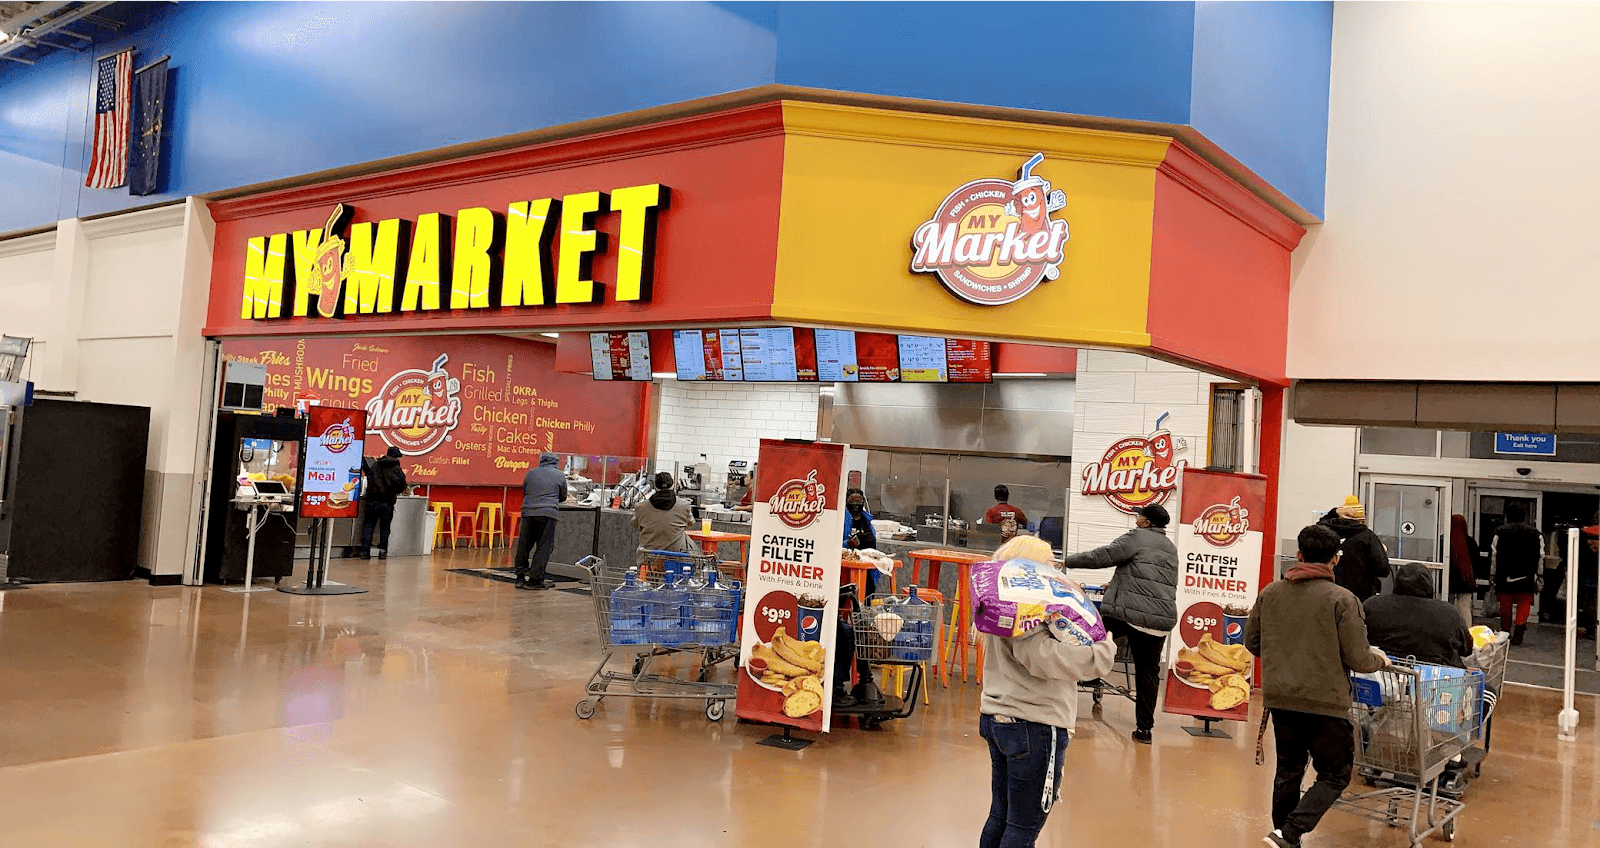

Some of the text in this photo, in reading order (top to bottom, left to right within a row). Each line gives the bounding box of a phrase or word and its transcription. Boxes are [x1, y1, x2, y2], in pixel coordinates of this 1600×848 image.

[950, 190, 1006, 217] FISH CHICKEN
[967, 215, 1001, 229] MY
[915, 221, 1067, 264] Market
[241, 184, 660, 320] MY MARKET
[954, 267, 1032, 293] SANDWICHES SHRIMP
[260, 350, 291, 366] Fries
[342, 353, 379, 372] Fried
[462, 362, 495, 383] Fish
[306, 367, 373, 398] Wings
[400, 394, 420, 404] MY
[464, 385, 502, 401] Grilled
[513, 386, 537, 396] OKRA
[512, 396, 528, 406] Legs
[538, 399, 558, 409] Thighs
[367, 399, 457, 427] Market
[473, 405, 527, 424] Chicken
[535, 417, 595, 434] Chicken Philly
[497, 427, 538, 444] Cakes
[1505, 434, 1529, 442] Thank
[455, 440, 487, 451] Oysters
[497, 445, 510, 453] Mac
[518, 446, 542, 455] Cheese
[1119, 440, 1144, 449] CHICKEN
[429, 456, 470, 466] Catfish Fillet
[494, 456, 530, 472] Burgers
[1117, 456, 1140, 467] MY
[308, 471, 335, 481] Meal
[411, 464, 438, 476] Perch
[770, 496, 823, 512] Market
[1194, 518, 1246, 534] Market
[762, 534, 814, 550] CATFISH
[761, 546, 813, 563] FILLET
[1187, 553, 1238, 565] CATFISH
[760, 560, 824, 581] DINNER
[1186, 563, 1237, 578] FILLET
[759, 575, 776, 583] With
[777, 577, 794, 586] Fries
[803, 581, 823, 589] Drink
[1185, 575, 1247, 592] DINNER
[1202, 589, 1219, 598] Fries
[1229, 592, 1247, 600] Drink
[762, 606, 791, 624] $9.99
[1185, 615, 1217, 631] $9.99
